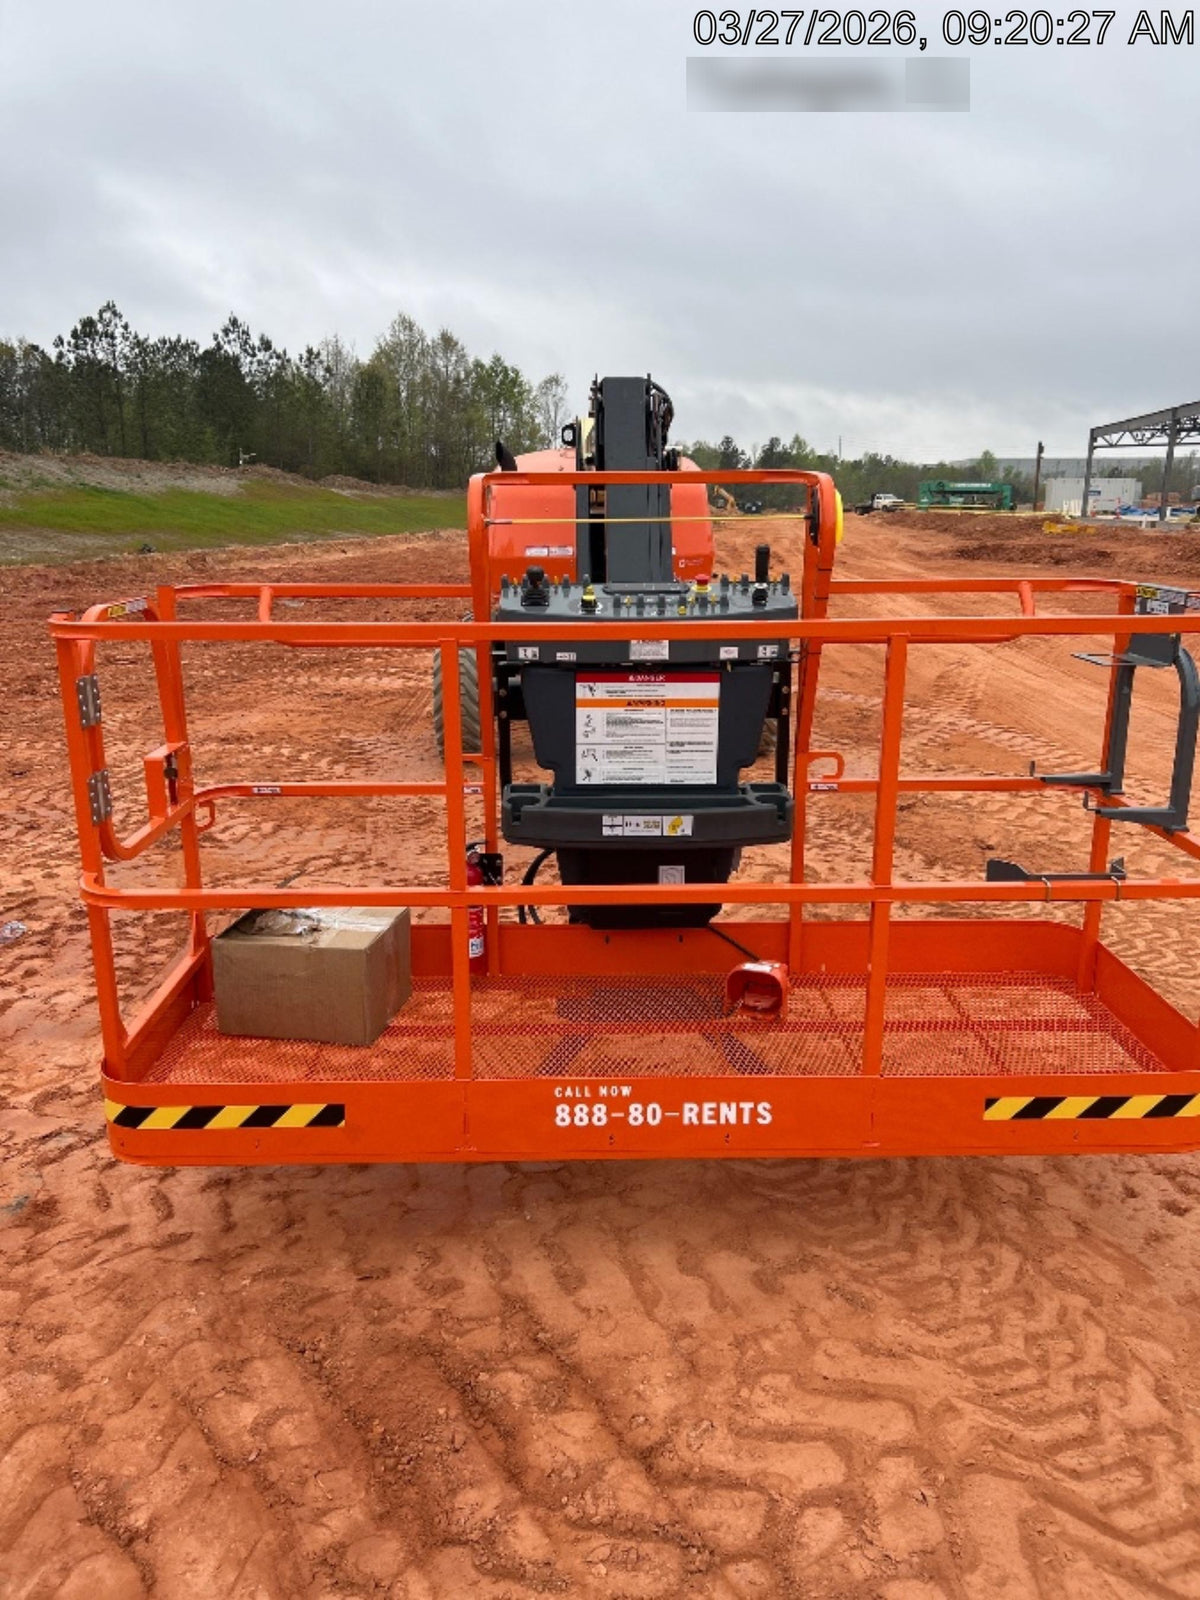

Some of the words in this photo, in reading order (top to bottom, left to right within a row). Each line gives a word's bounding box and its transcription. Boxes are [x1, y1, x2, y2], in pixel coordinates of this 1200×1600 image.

[554, 1085, 591, 1098] CALL
[598, 1085, 632, 1097] NOW
[554, 1102, 773, 1127] 888-80-RENTS
